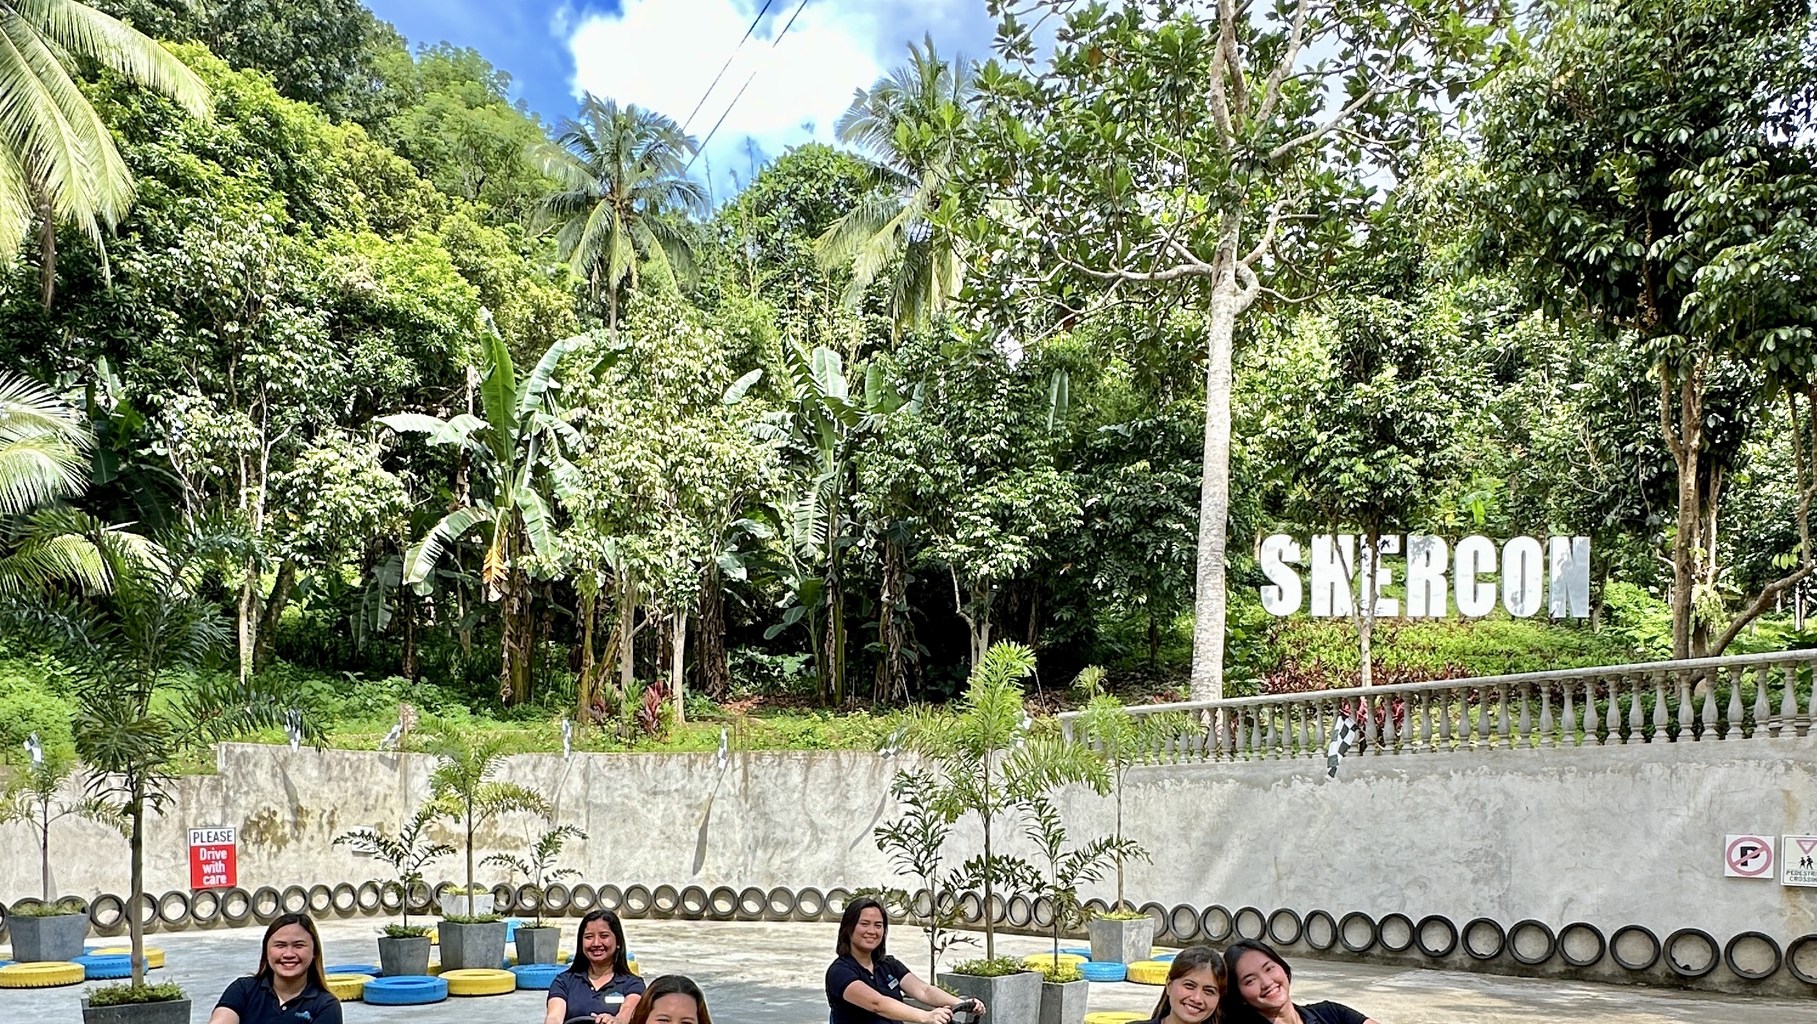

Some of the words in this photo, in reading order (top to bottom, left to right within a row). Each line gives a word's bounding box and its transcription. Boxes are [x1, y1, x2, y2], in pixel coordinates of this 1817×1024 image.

[1260, 534, 1591, 618] SHERCON
[193, 831, 233, 843] PLEASE
[200, 847, 228, 861] Drive
[1740, 846, 1761, 867] P
[202, 861, 226, 874] with
[203, 875, 228, 885] care
